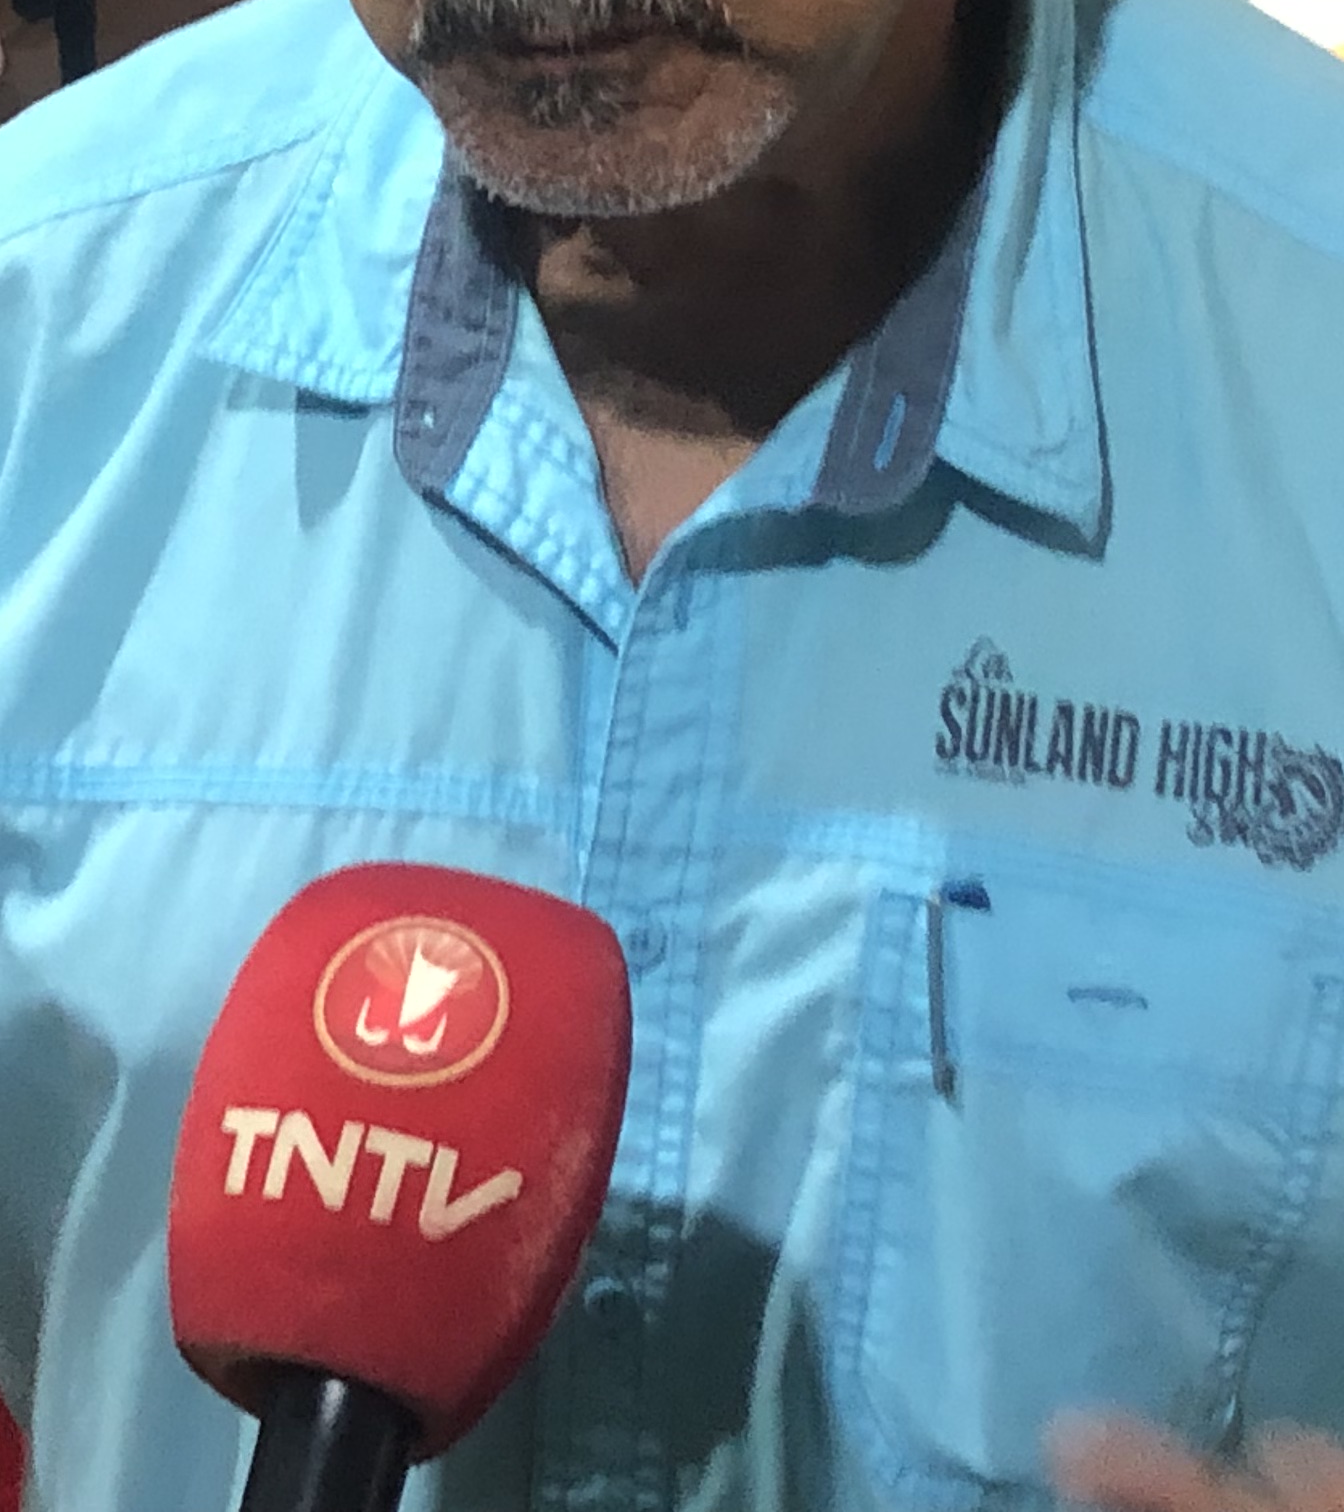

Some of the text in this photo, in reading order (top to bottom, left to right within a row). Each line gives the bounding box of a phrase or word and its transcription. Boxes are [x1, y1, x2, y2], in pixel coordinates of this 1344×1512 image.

[935, 684, 1267, 807] SUNLAND HIGH
[221, 1104, 523, 1243] TNTV
